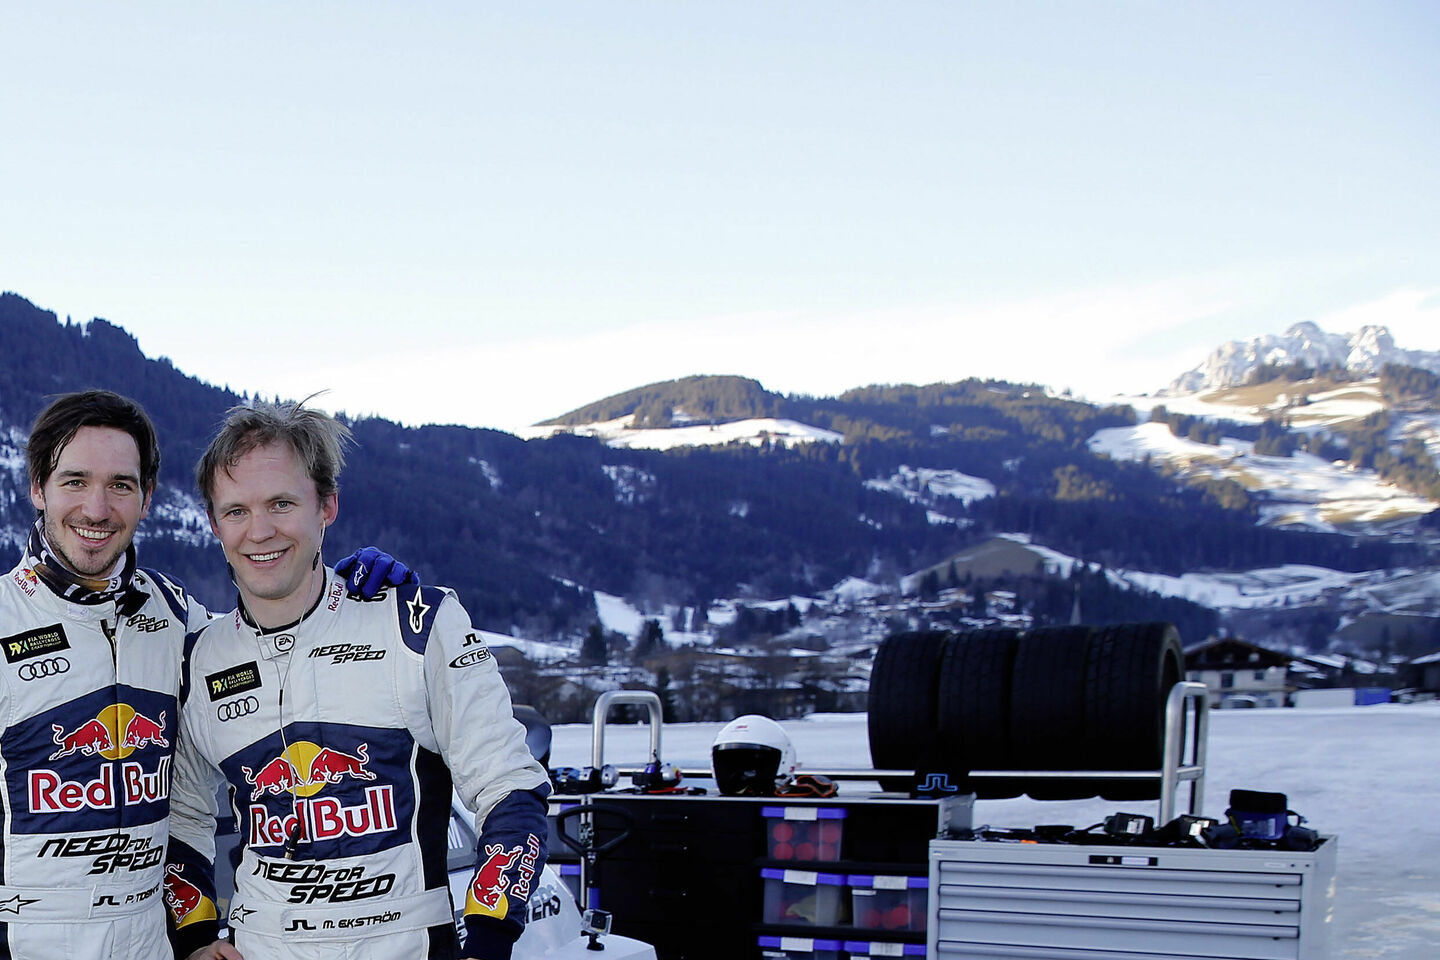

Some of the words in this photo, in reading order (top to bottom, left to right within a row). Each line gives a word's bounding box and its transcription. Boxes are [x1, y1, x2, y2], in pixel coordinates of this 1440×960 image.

[308, 643, 352, 658] NEED
[330, 649, 387, 665] SPEED
[28, 763, 115, 814] Red
[122, 755, 171, 808] Bull
[249, 801, 308, 848] Red
[309, 785, 398, 842] Bull
[37, 834, 130, 857] NEED
[124, 837, 152, 853] FOR
[85, 845, 163, 876] SPEED
[521, 833, 540, 868] Bull
[252, 859, 326, 883] NEED
[318, 866, 365, 884] FOR
[510, 866, 535, 902] Red
[287, 873, 396, 904] SPEED
